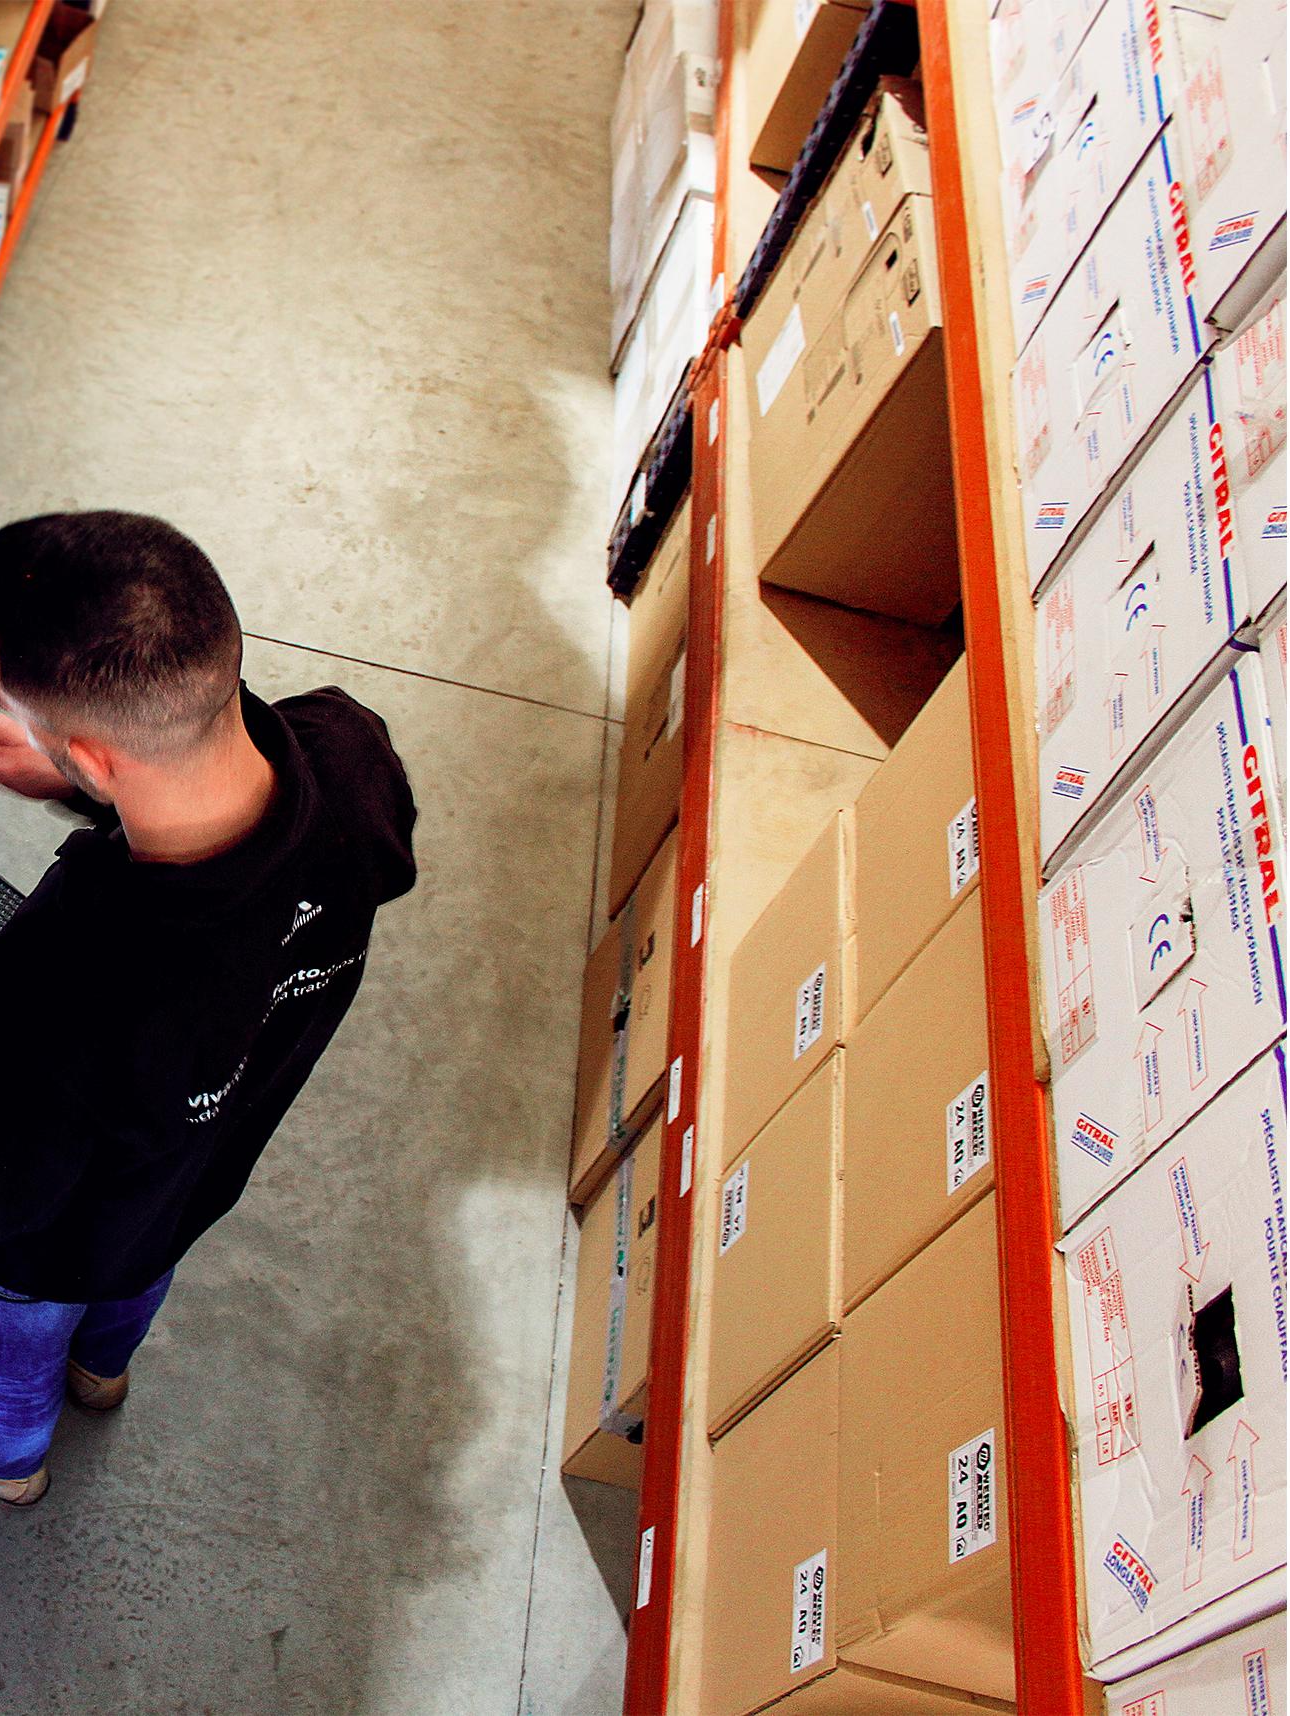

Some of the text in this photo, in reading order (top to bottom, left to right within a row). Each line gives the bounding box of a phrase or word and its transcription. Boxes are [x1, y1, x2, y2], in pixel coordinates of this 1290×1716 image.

[1169, 182, 1197, 297] GITRAL
[1209, 422, 1234, 559] GITRAL
[1243, 744, 1280, 924] GITRAL
[1076, 1118, 1115, 1150] GITRAL
[1113, 1541, 1154, 1594] GITRAL
